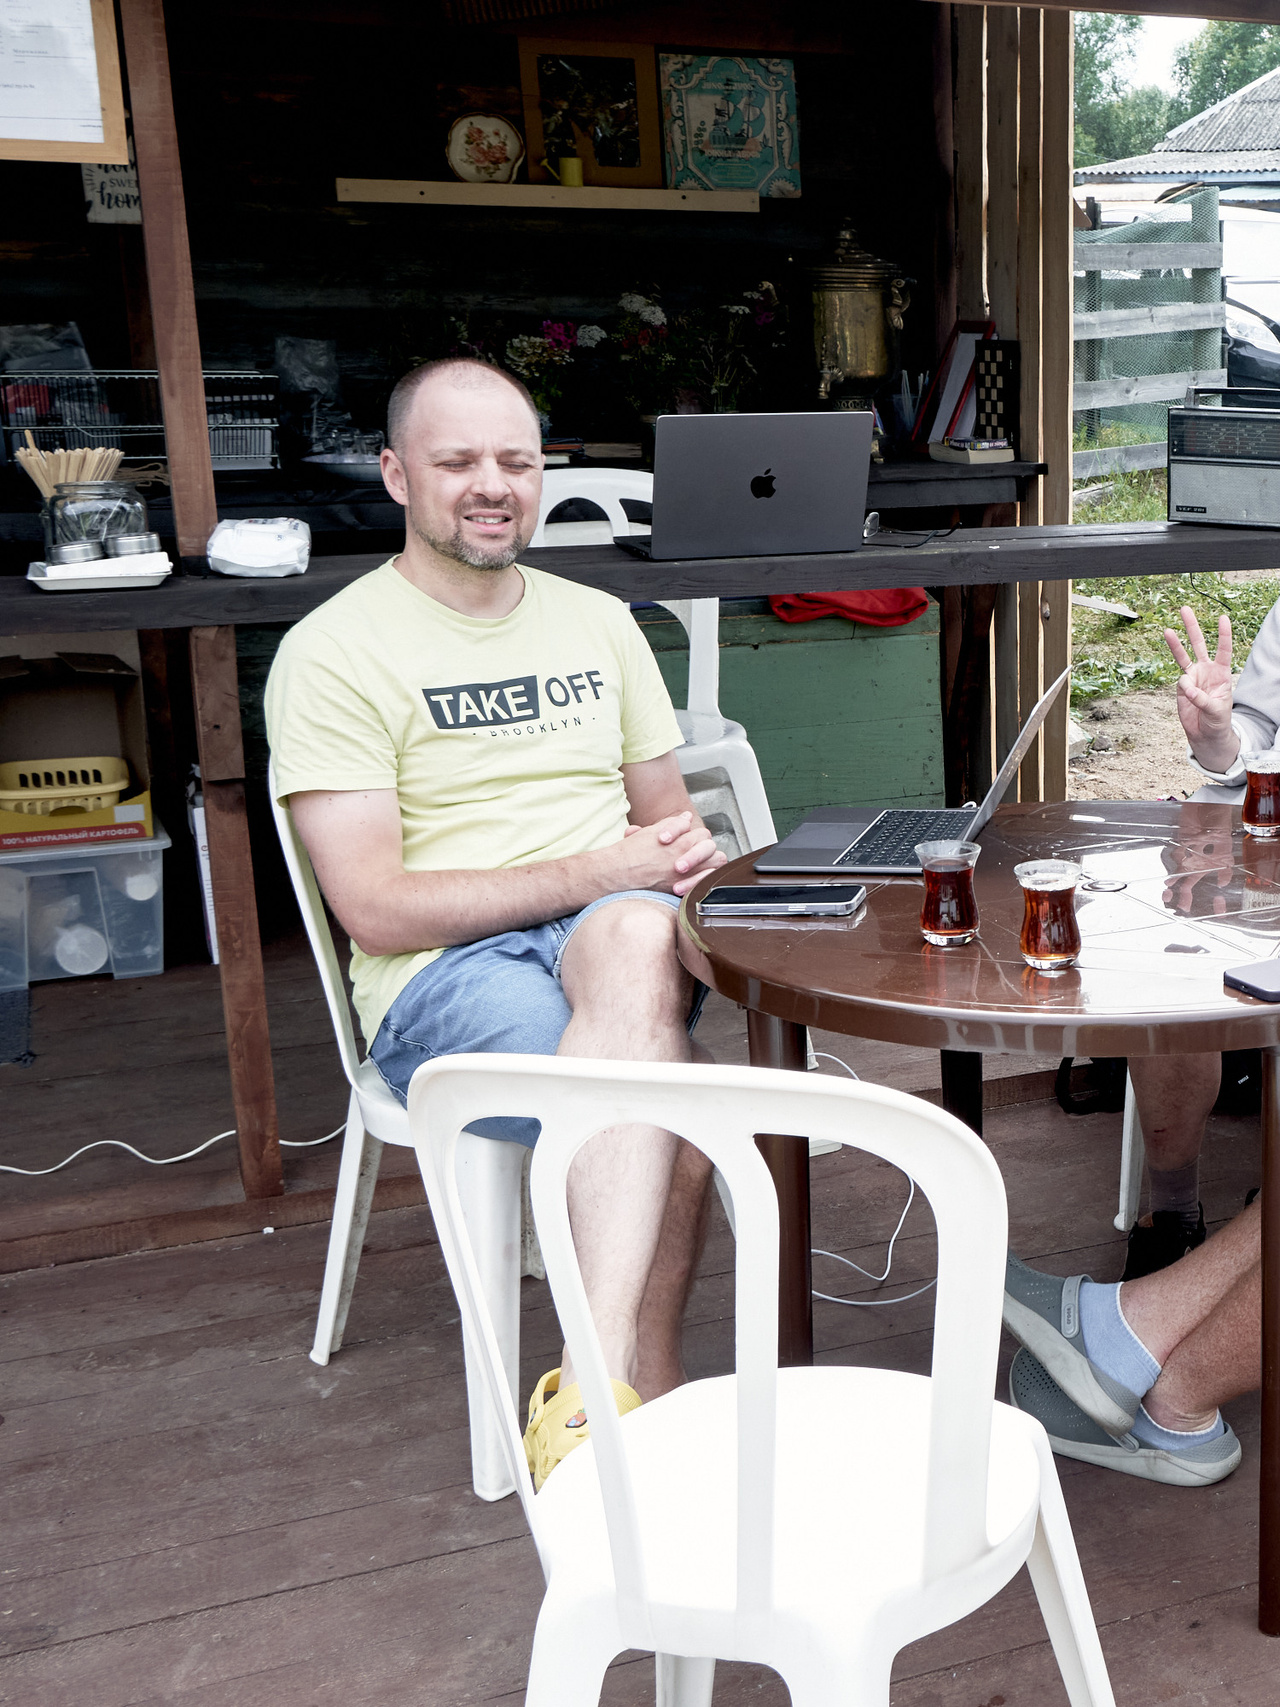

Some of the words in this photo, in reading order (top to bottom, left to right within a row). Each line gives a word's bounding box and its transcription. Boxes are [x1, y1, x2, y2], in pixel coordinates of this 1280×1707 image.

[97, 181, 140, 209] hom
[430, 684, 534, 725] TAKE
[544, 670, 604, 707] OFF
[490, 716, 582, 737] BROOKLYN
[25, 830, 88, 843] НАТУРАЛЬНЫЙ
[89, 827, 139, 838] КАРТОФЕЛЬ
